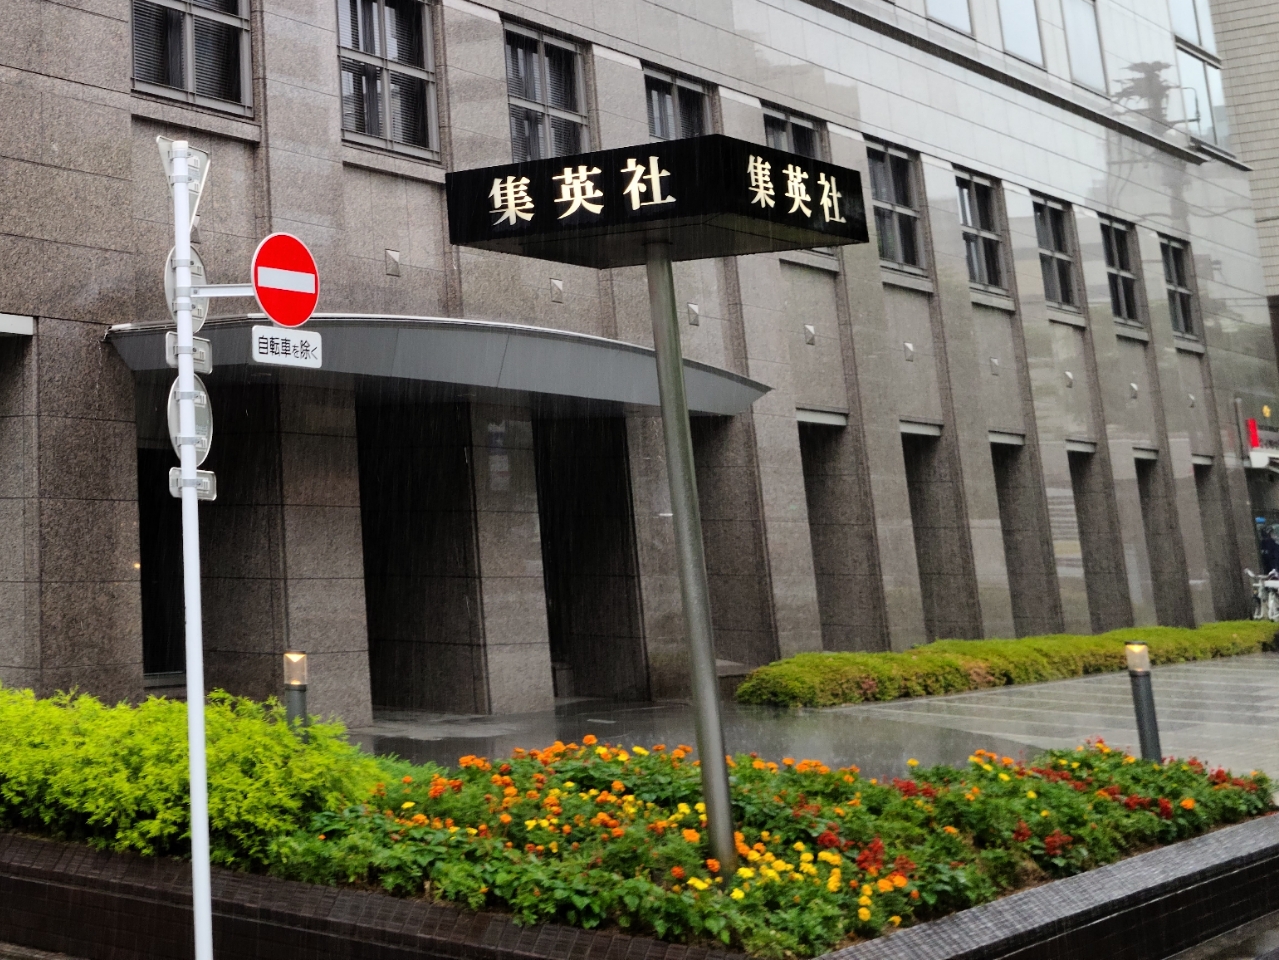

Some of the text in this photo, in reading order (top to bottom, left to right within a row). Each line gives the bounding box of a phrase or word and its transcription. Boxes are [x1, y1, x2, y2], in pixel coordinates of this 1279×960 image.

[488, 155, 677, 226] 集英社
[747, 154, 846, 224] 集英社
[258, 335, 318, 360] 自転車を除く
